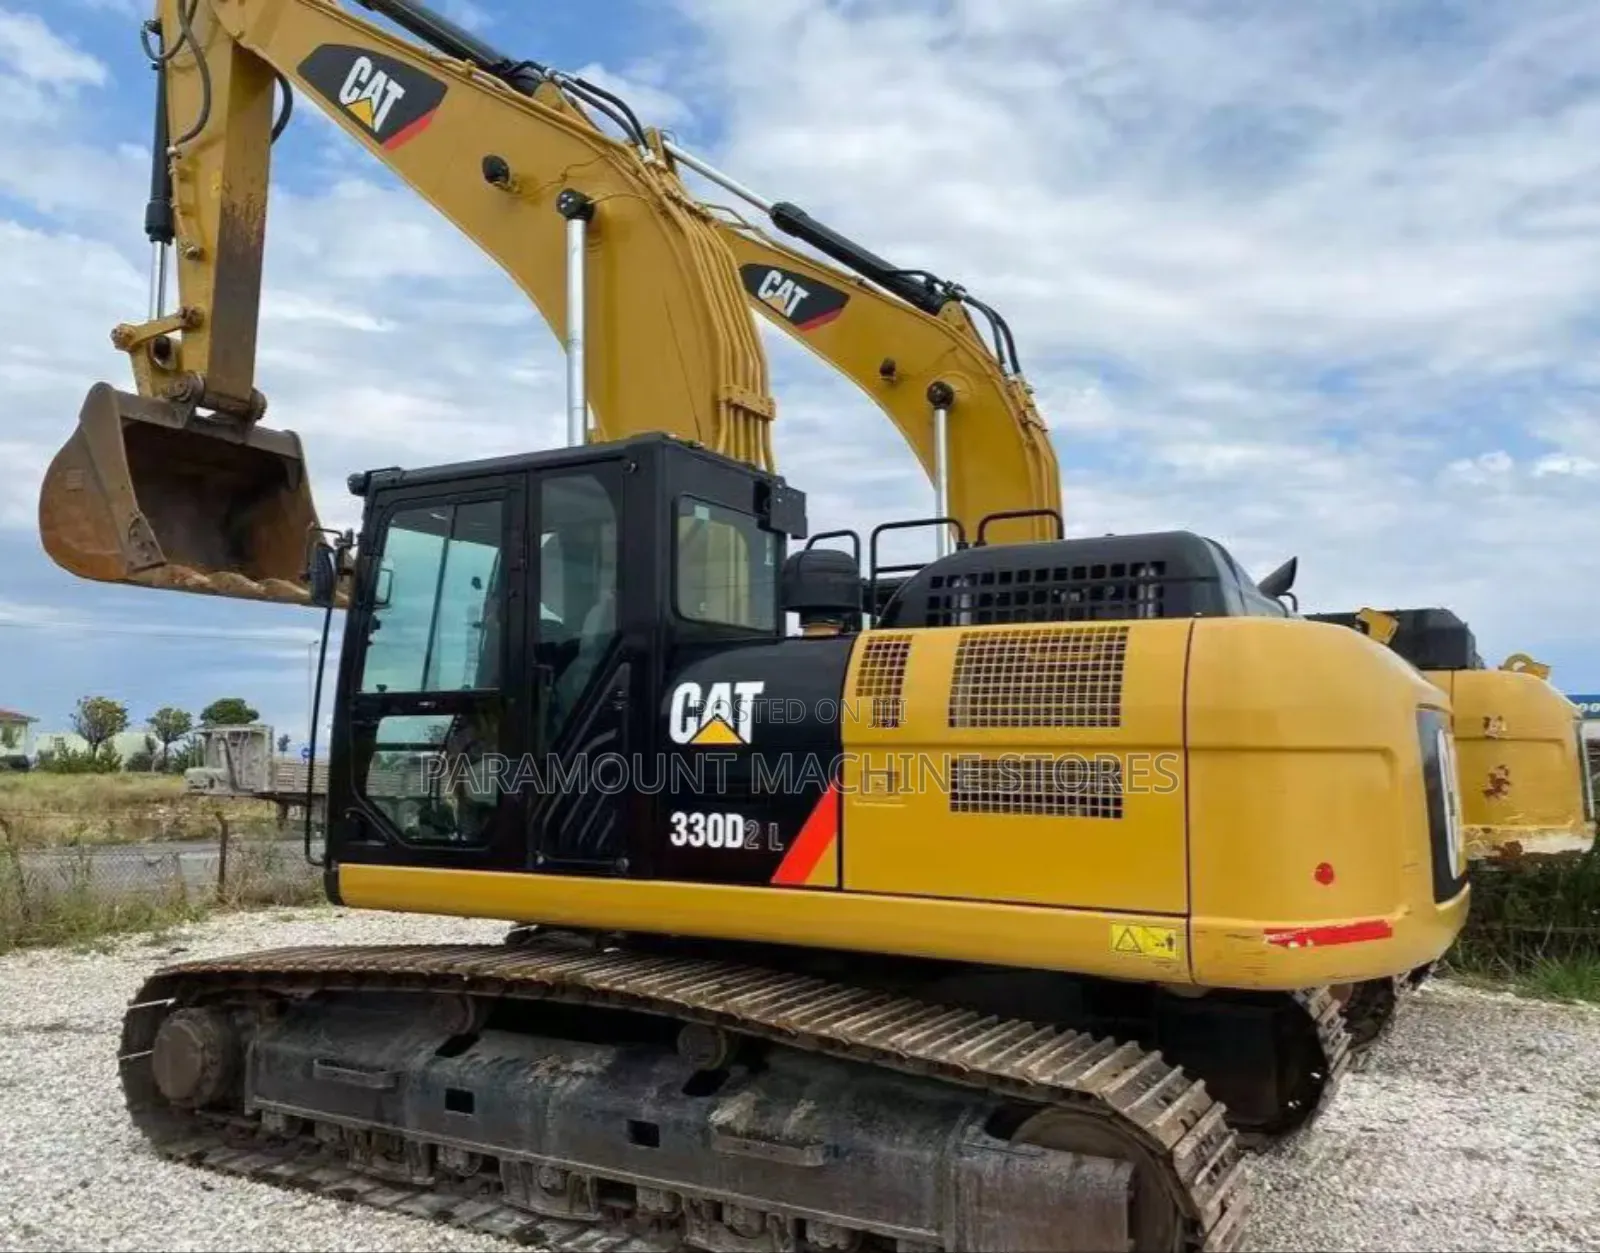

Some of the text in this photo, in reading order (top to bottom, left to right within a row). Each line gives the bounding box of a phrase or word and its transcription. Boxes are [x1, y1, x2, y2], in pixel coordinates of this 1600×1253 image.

[339, 56, 405, 132] CAT
[758, 269, 810, 317] CAT
[669, 681, 764, 744] CAT
